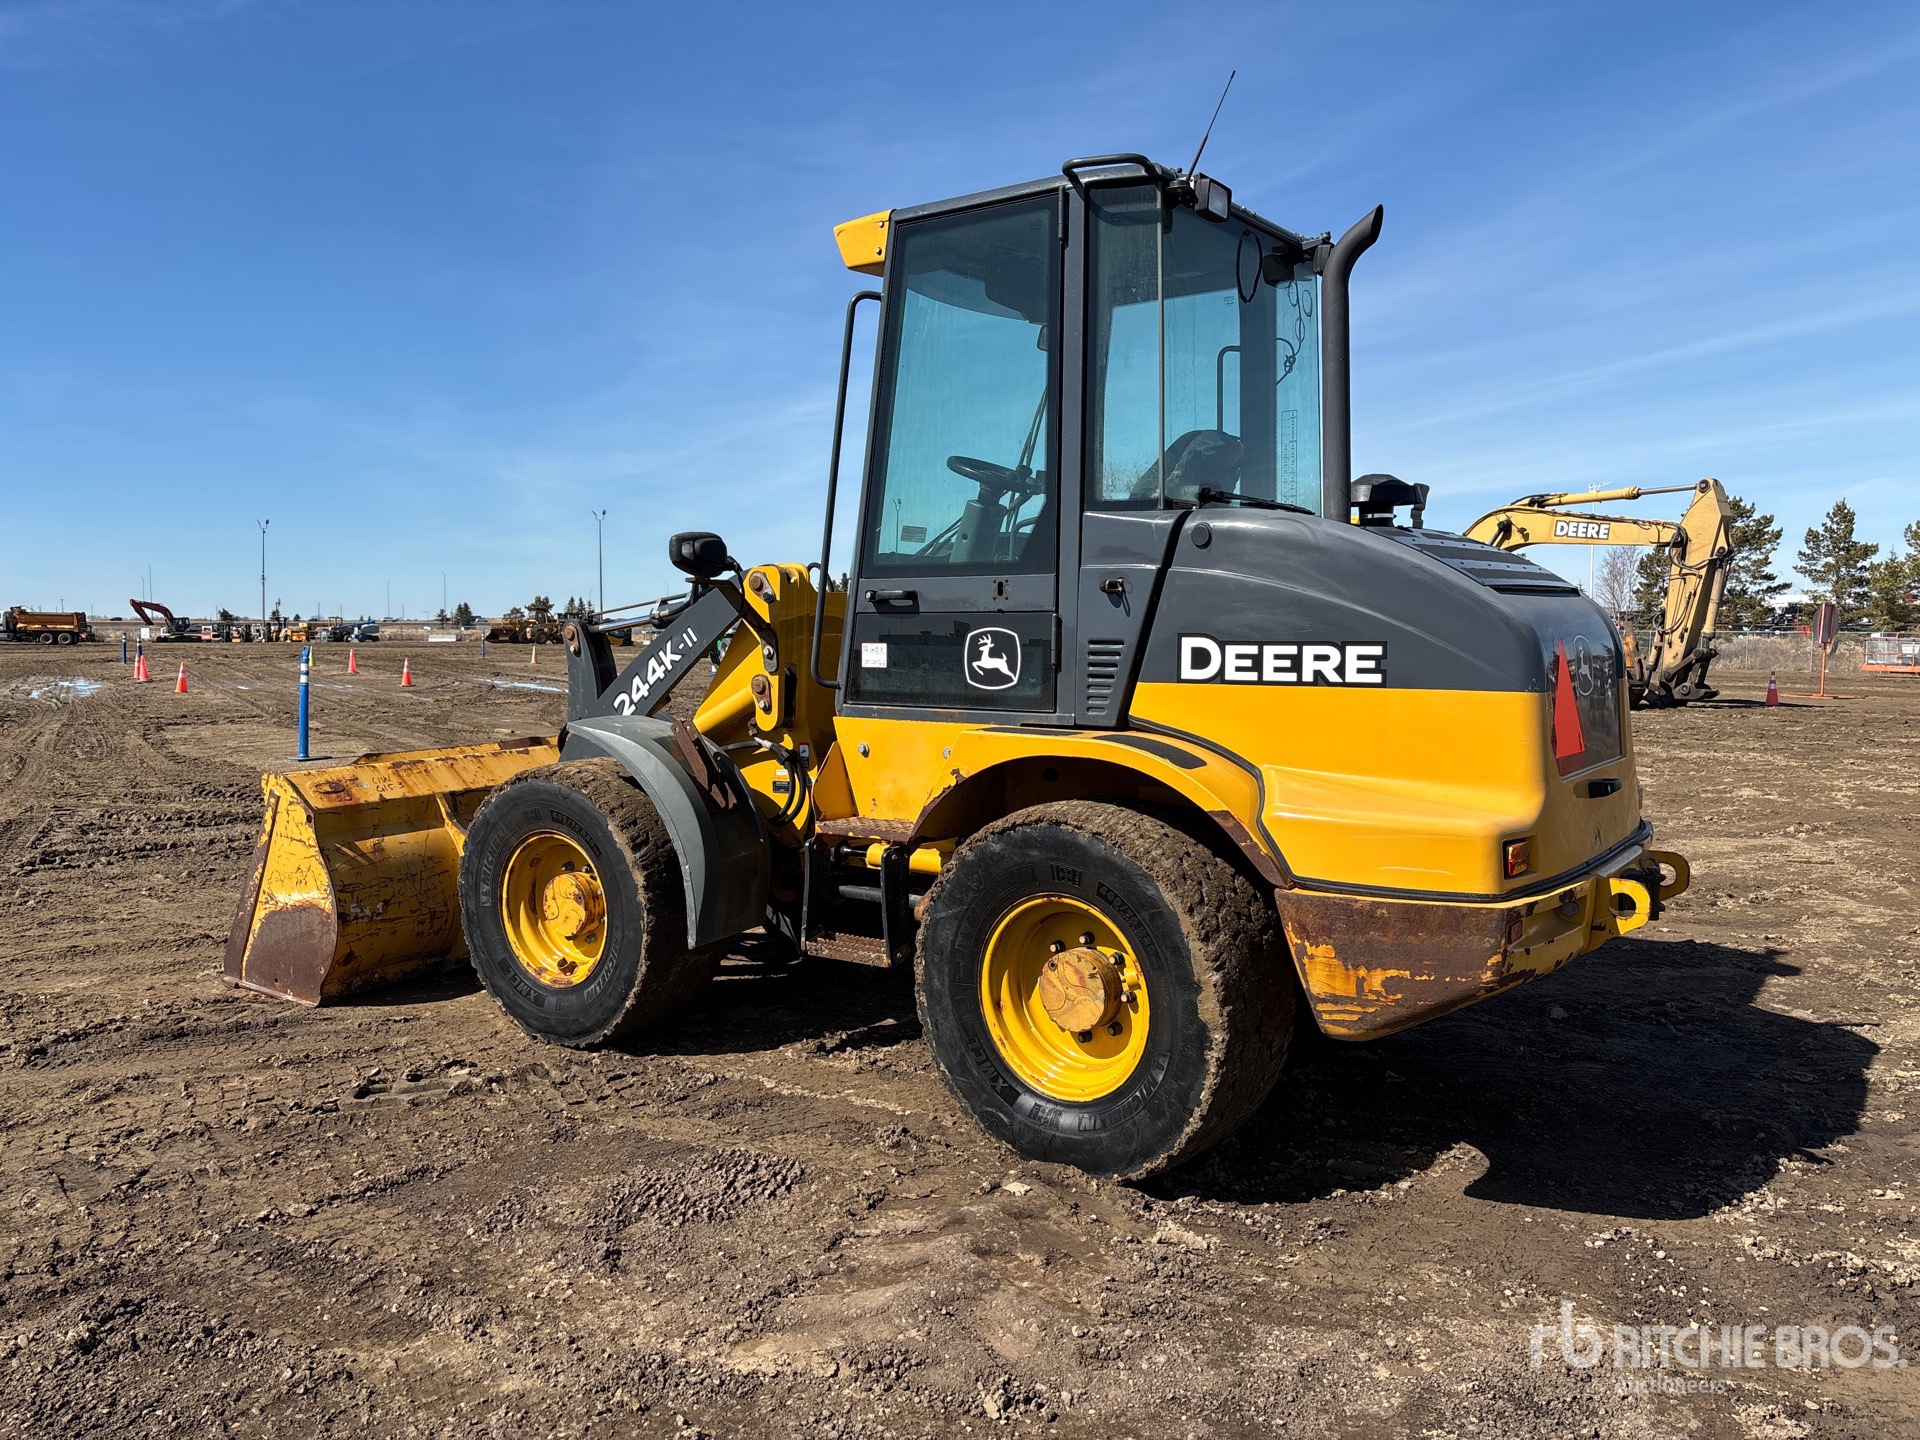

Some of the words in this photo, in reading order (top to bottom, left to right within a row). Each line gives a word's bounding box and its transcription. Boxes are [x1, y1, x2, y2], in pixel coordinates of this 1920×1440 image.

[1555, 521, 1610, 539] DEERE
[1180, 636, 1383, 684] DEERE
[506, 966, 539, 1003] XMCL
[967, 1036, 1009, 1088] XMCL
